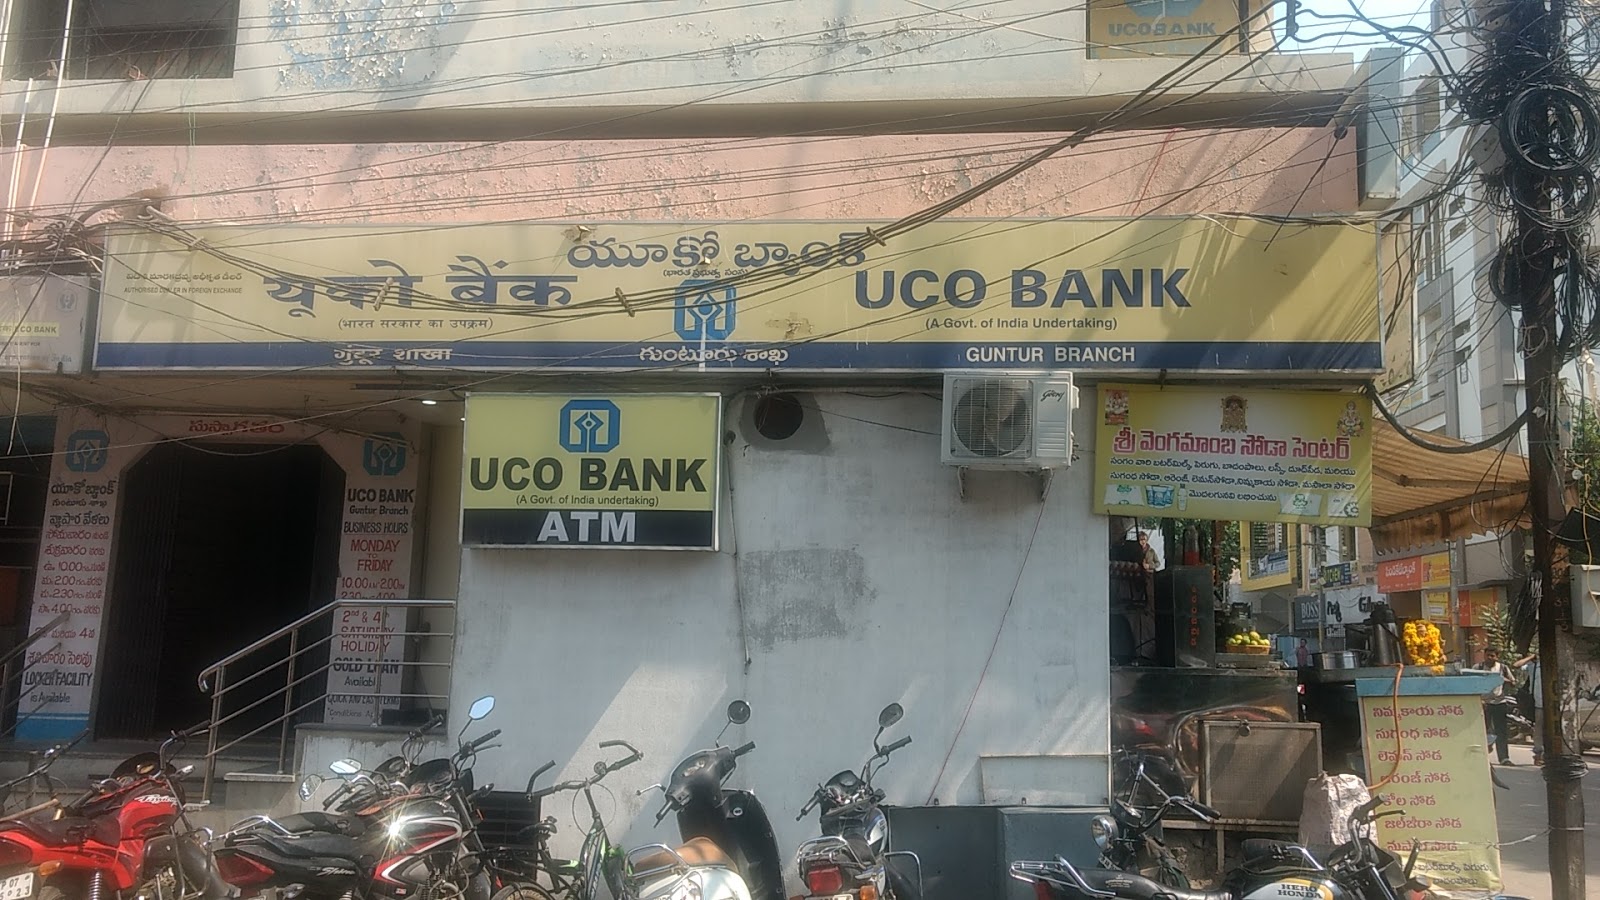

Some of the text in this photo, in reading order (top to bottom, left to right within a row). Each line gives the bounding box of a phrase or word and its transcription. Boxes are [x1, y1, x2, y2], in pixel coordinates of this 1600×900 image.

[855, 268, 1192, 308] UCO BANK
[34, 326, 57, 334] BANK
[338, 317, 493, 331] (भारत सरकार का उपक्रम)
[925, 318, 1118, 331] (A Govt. of India Undertaking)
[393, 348, 453, 361] शाखा
[966, 347, 1135, 363] GUNTUR BRANCH
[1114, 427, 1136, 454] శ్రీ
[1140, 430, 1236, 455] వెంగమాంబ
[1240, 434, 1287, 457] సోడా
[470, 457, 707, 492] UCO BANK
[347, 488, 414, 503] UCO BANK
[516, 494, 659, 507] (A Govt. of India undertaking)
[350, 505, 408, 515] Guntur Branch
[344, 522, 408, 534] BUSINESS HOURS
[537, 512, 636, 542] ATM
[350, 540, 399, 552] MONDAY
[357, 559, 393, 571] FRIDAY
[362, 611, 368, 623] &
[333, 657, 362, 672] GOLD
[25, 671, 93, 686] LOCKER FACILITY
[344, 676, 381, 687] Availabl
[9, 878, 19, 888] 07
[1281, 884, 1318, 893] HERO
[1277, 890, 1323, 899] HONDA
